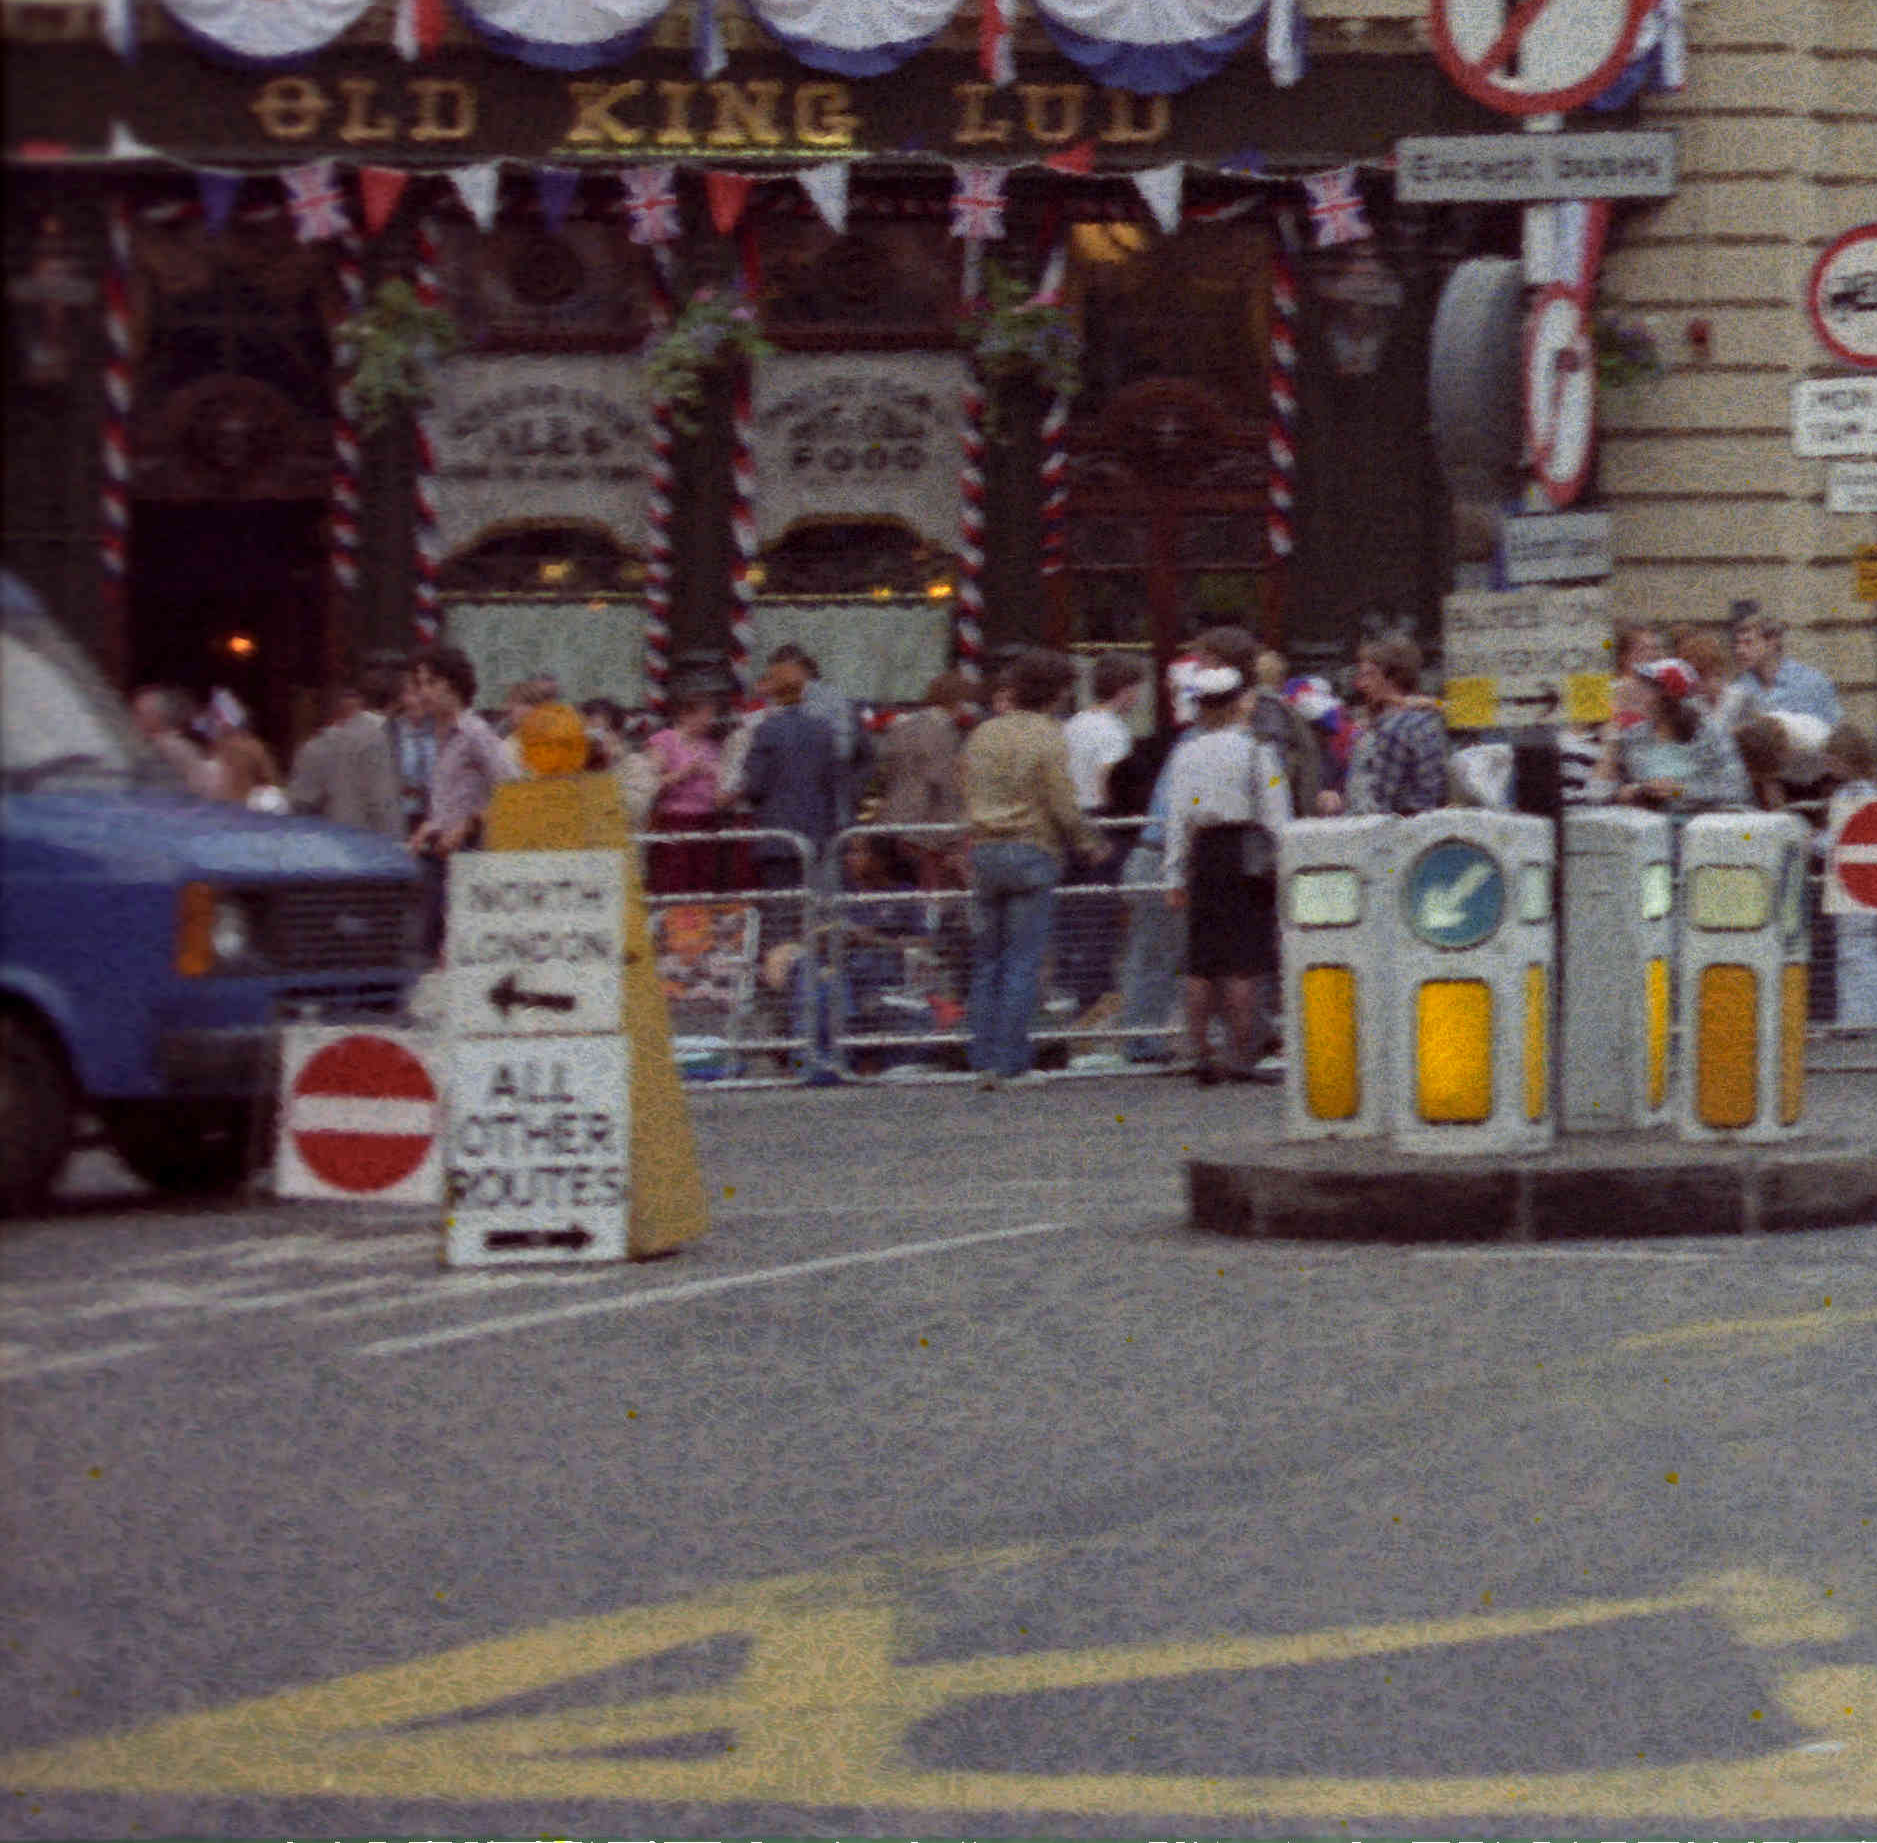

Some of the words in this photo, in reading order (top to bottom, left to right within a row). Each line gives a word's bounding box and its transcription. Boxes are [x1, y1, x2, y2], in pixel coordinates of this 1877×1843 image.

[251, 76, 478, 143] OLD
[567, 79, 860, 145] KING
[952, 83, 1170, 143] LUD
[469, 880, 603, 912] NORTH
[457, 931, 610, 965] LONDON
[488, 1061, 575, 1103] ALL
[458, 1113, 611, 1157] OTHER
[446, 1165, 622, 1208] ROUTES
